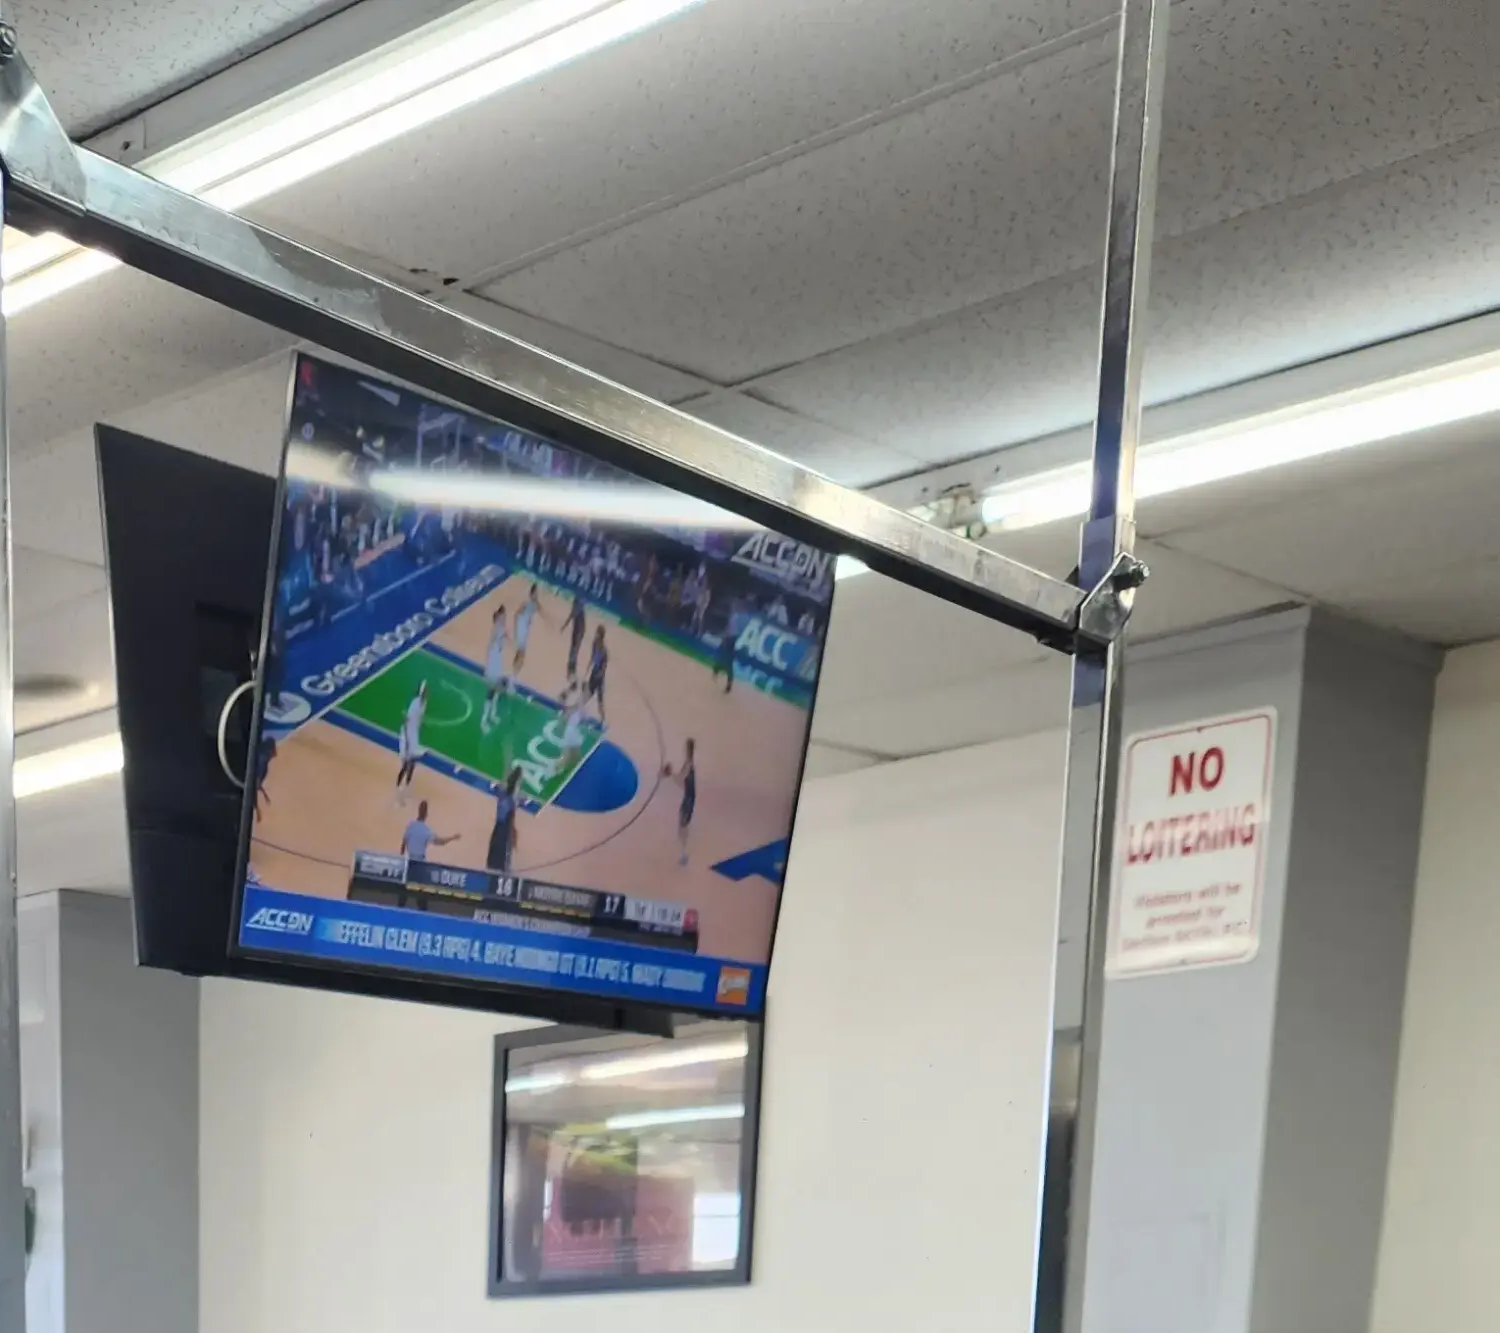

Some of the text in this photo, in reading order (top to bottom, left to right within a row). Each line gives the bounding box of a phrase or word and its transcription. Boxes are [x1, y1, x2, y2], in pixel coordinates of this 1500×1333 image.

[301, 612, 433, 696] Greensboro
[735, 617, 800, 671] ACC
[512, 719, 581, 794] ACC
[1170, 747, 1224, 796] NO
[1127, 803, 1256, 866] LOITERING
[604, 894, 621, 914] 17
